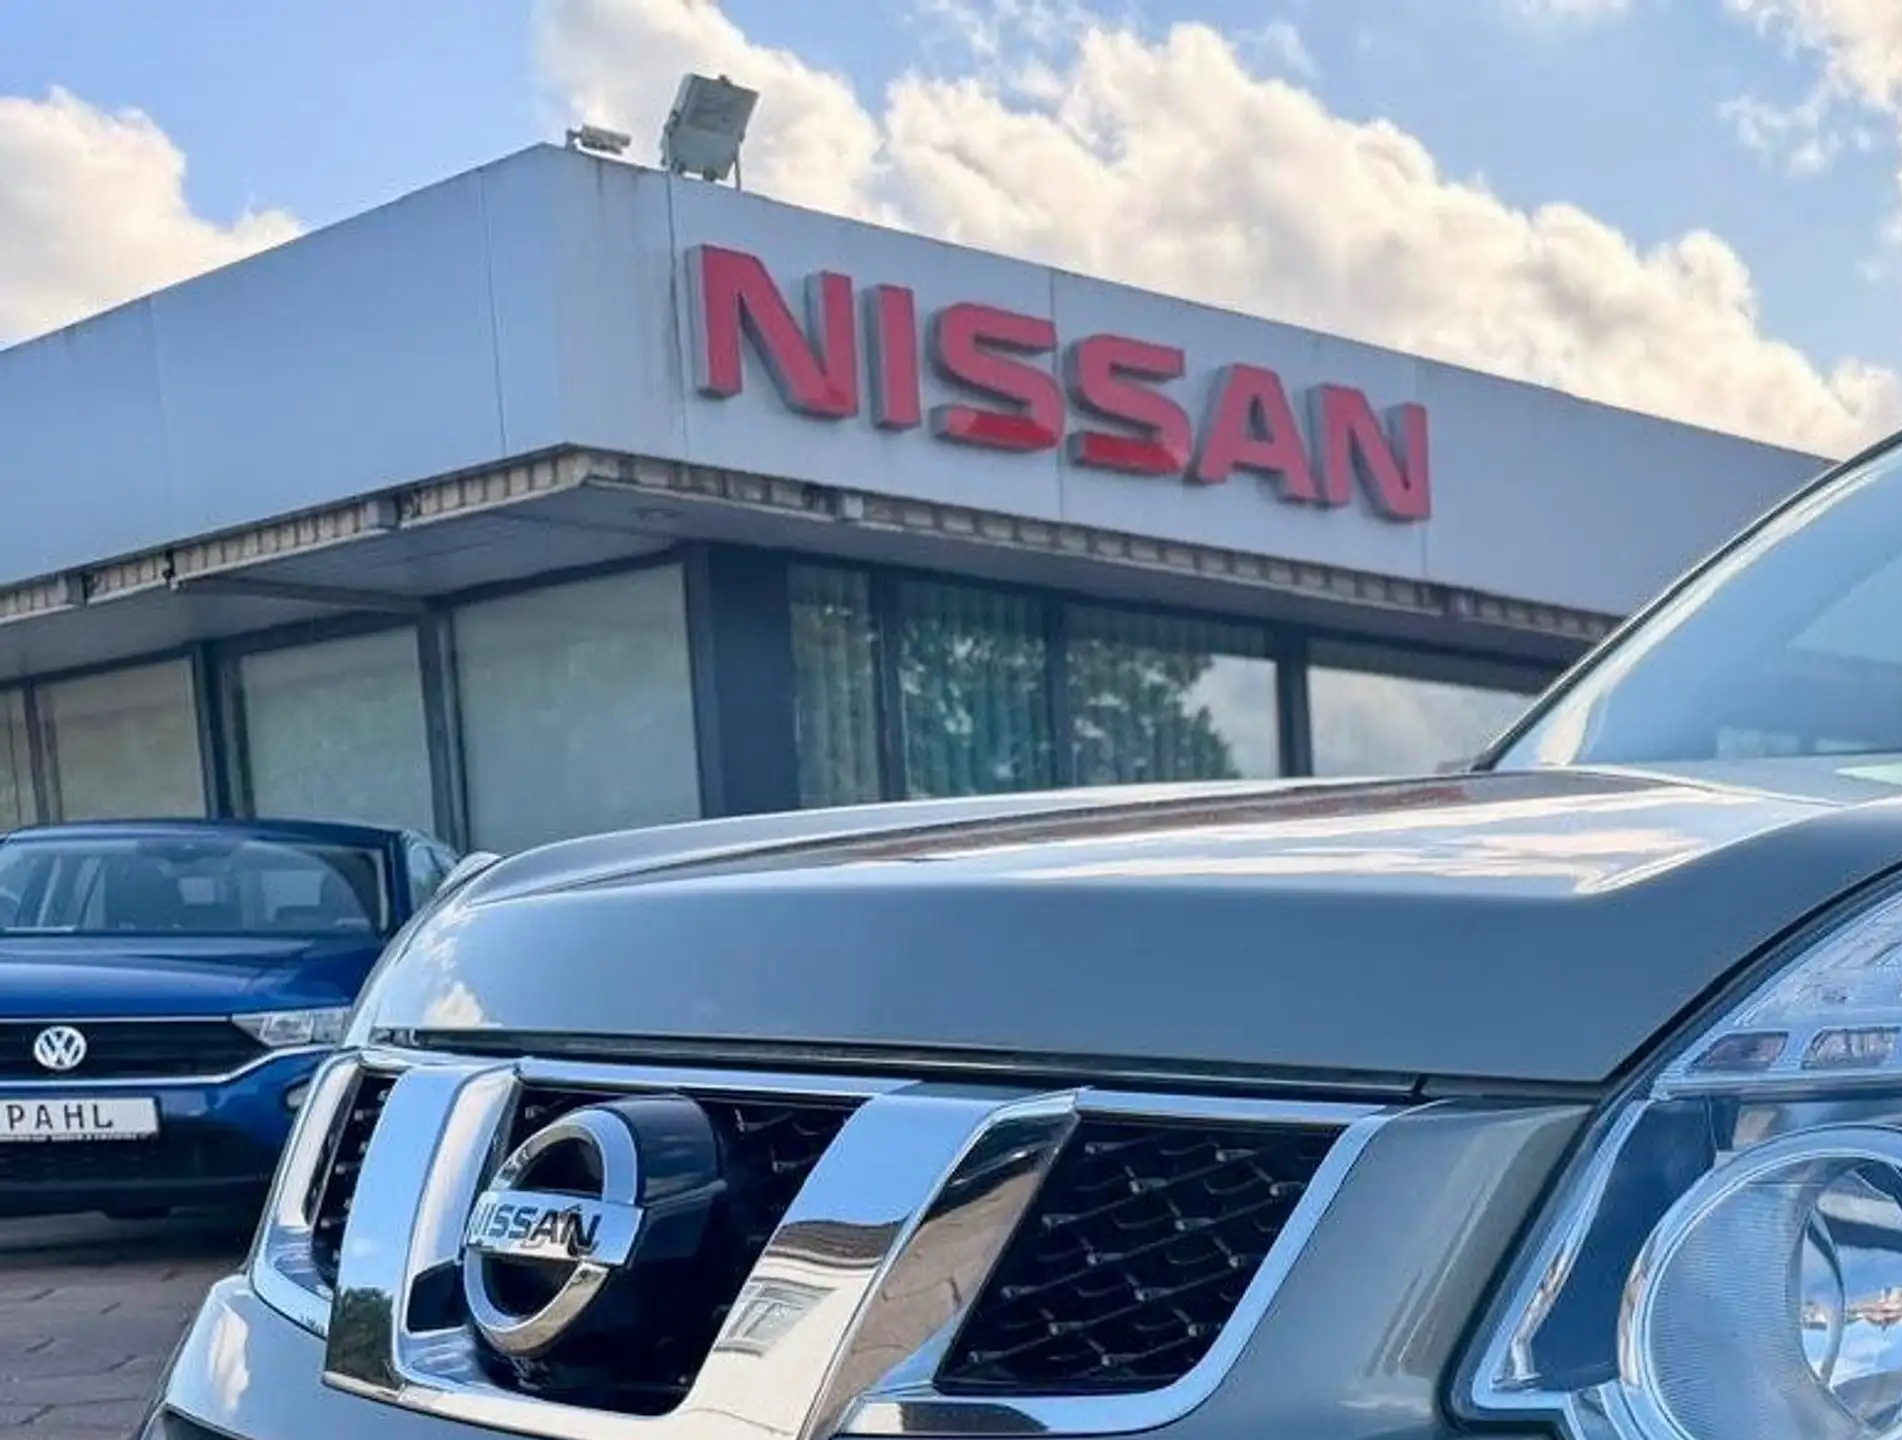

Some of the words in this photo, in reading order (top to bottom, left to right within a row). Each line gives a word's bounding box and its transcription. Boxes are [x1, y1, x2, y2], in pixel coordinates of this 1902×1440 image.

[690, 243, 1432, 523] NISSAN
[6, 1103, 114, 1131] PAHL
[467, 1202, 603, 1254] NISSAN
